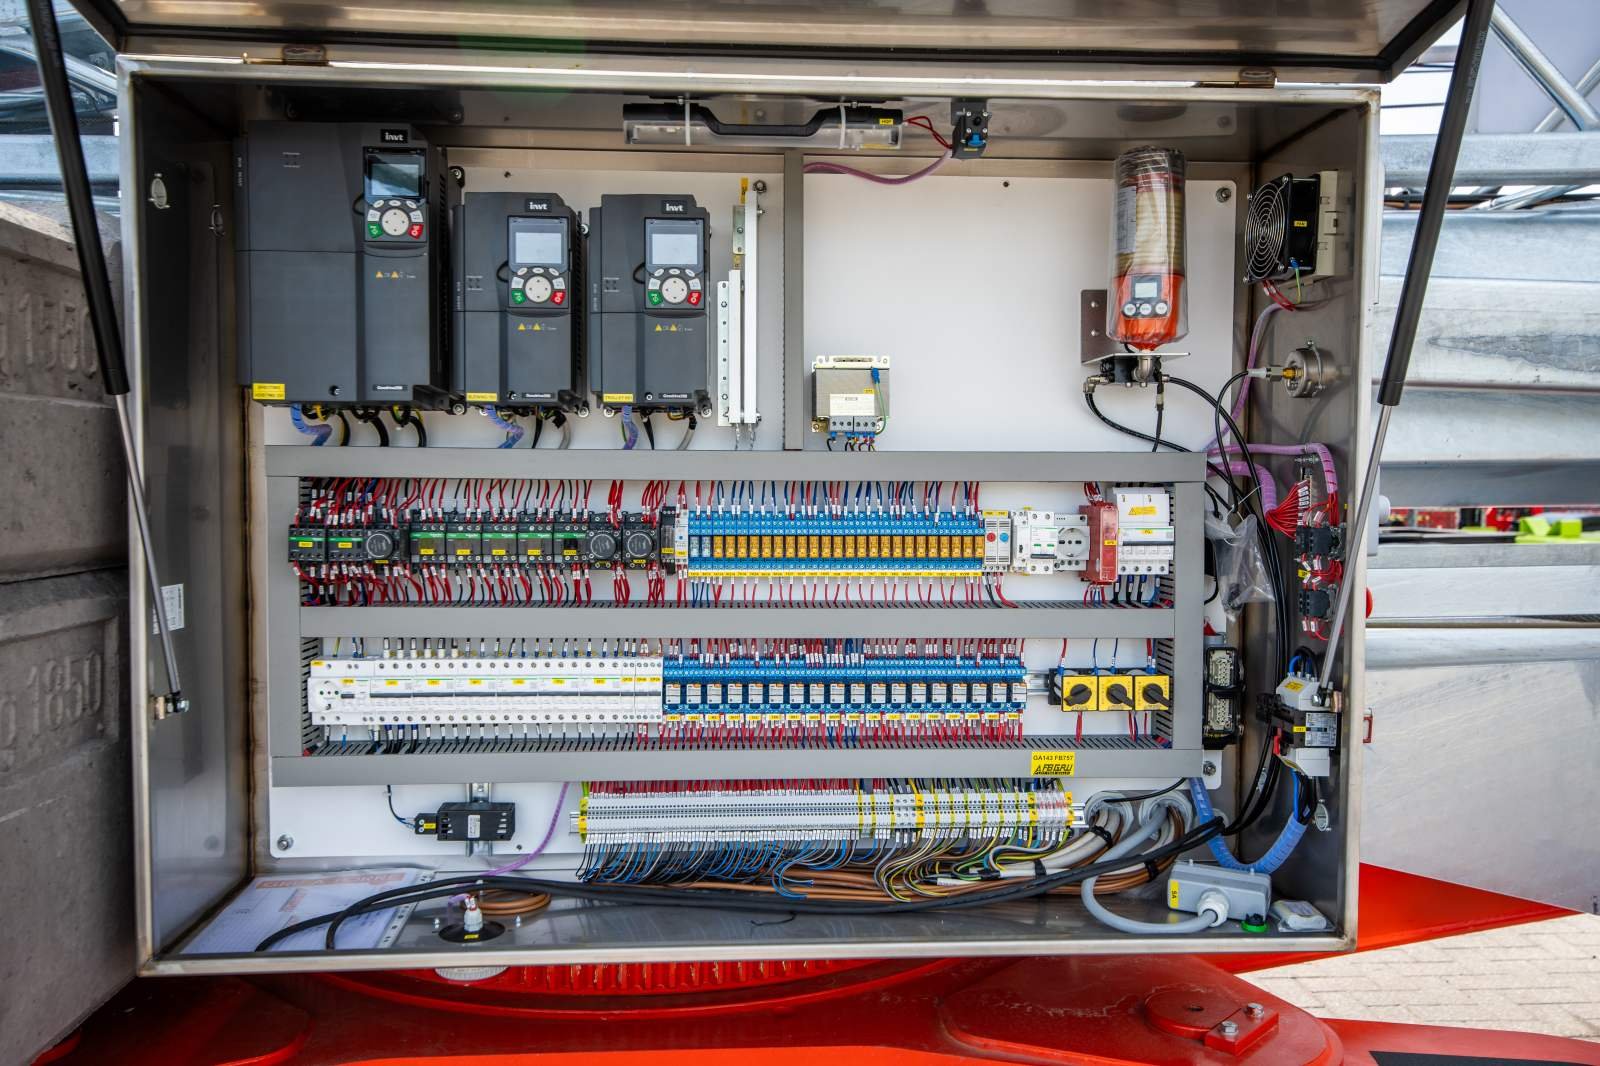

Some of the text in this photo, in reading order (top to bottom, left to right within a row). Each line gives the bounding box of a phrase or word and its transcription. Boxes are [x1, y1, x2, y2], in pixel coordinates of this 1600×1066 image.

[384, 132, 404, 141] invt
[529, 202, 548, 210] invt
[665, 203, 684, 212] invt
[26, 650, 102, 738] 1850
